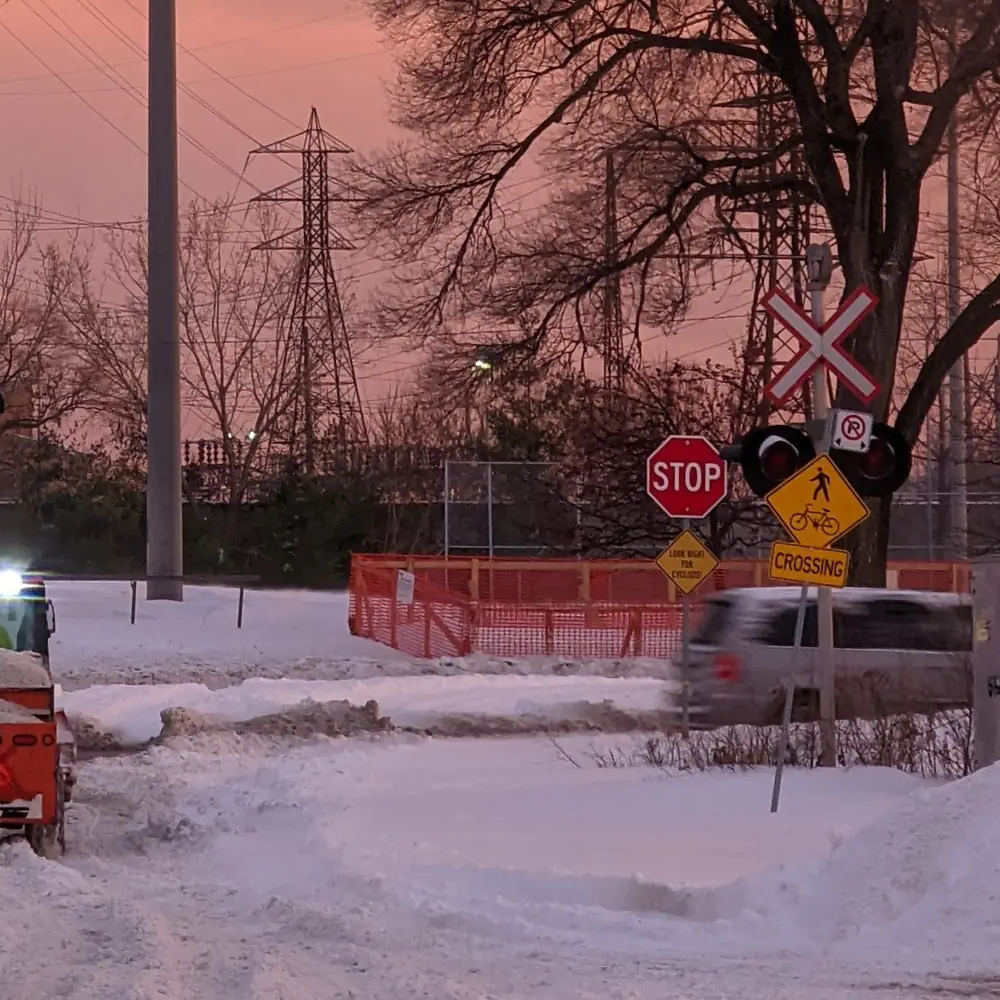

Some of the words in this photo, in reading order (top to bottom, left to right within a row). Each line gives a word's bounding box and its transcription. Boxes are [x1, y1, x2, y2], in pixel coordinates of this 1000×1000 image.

[847, 420, 860, 434] P
[652, 461, 721, 492] STOP
[669, 550, 686, 558] LOOK
[687, 550, 705, 558] RIGHT
[681, 560, 694, 569] FOR
[775, 552, 844, 577] CROSSING
